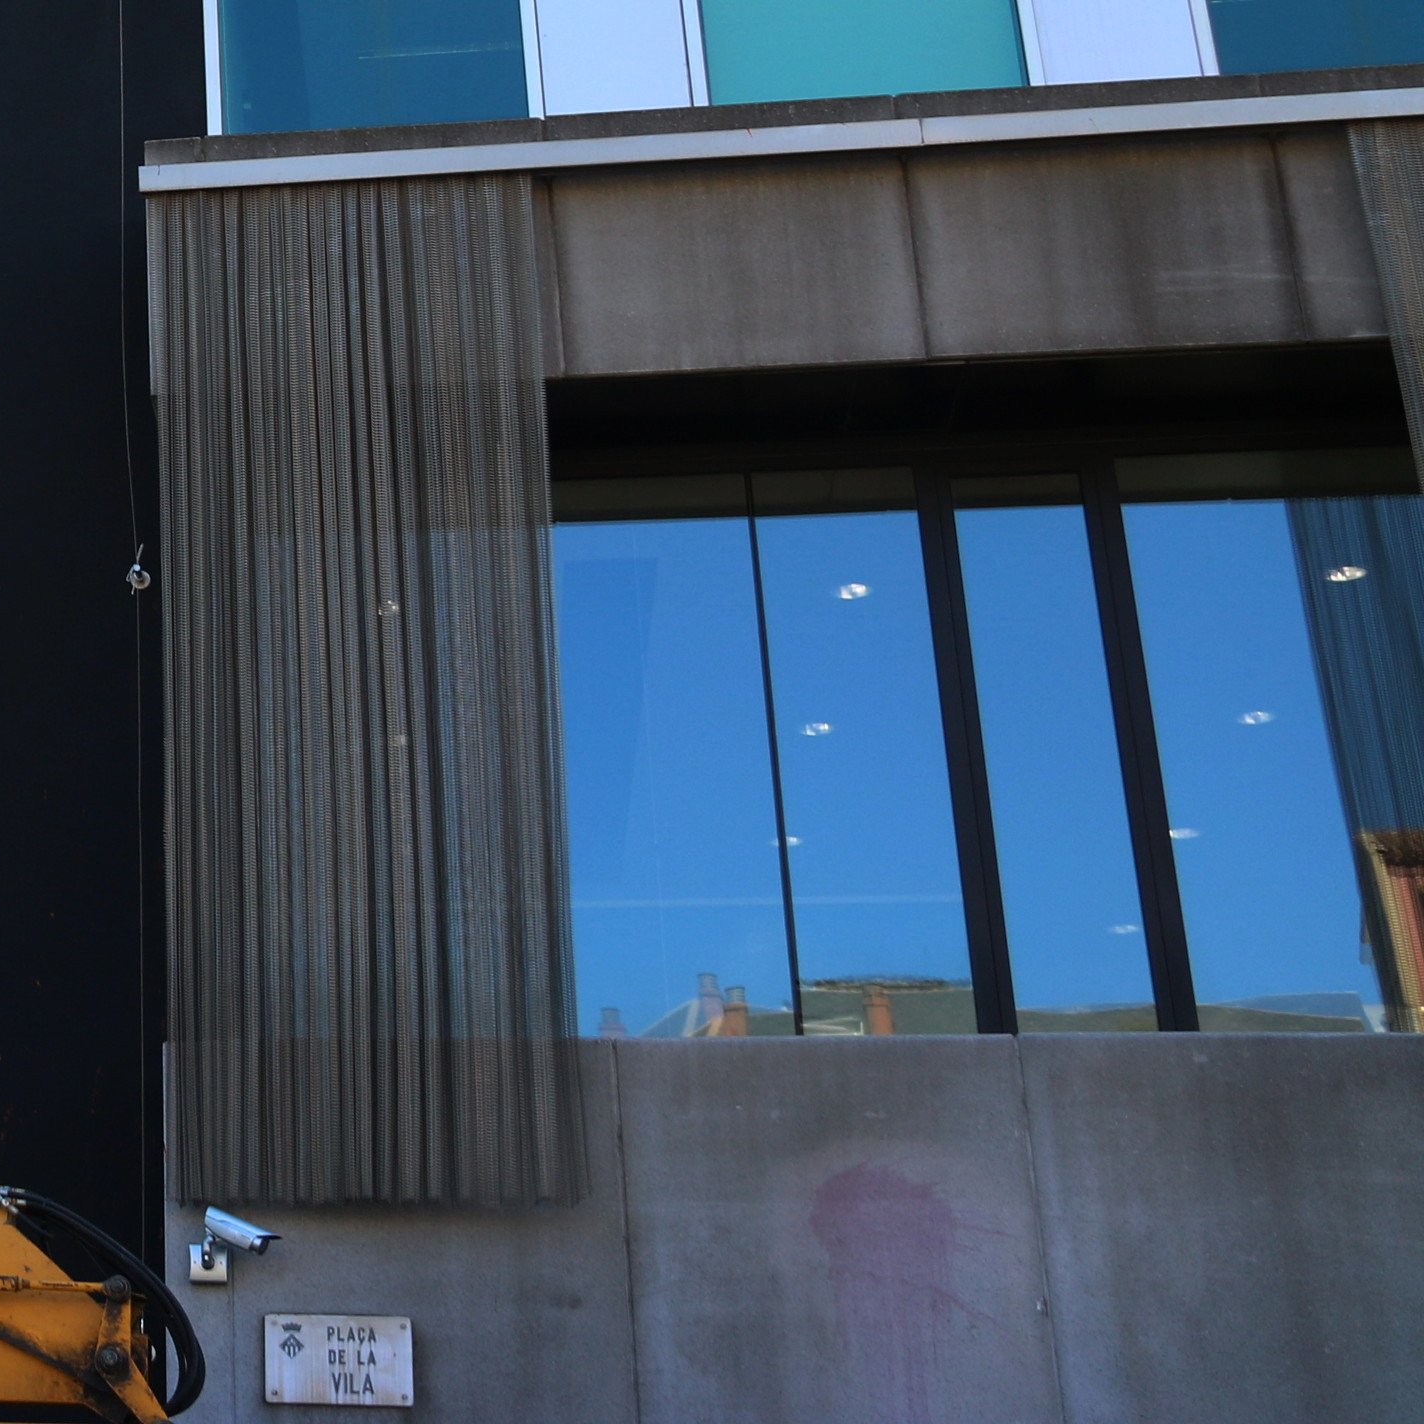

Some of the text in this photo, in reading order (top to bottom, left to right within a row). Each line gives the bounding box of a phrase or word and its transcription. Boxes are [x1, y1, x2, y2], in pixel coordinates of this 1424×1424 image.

[327, 1326, 377, 1345] PLAÇA
[328, 1349, 377, 1366] DE LA
[331, 1372, 375, 1395] VILA
